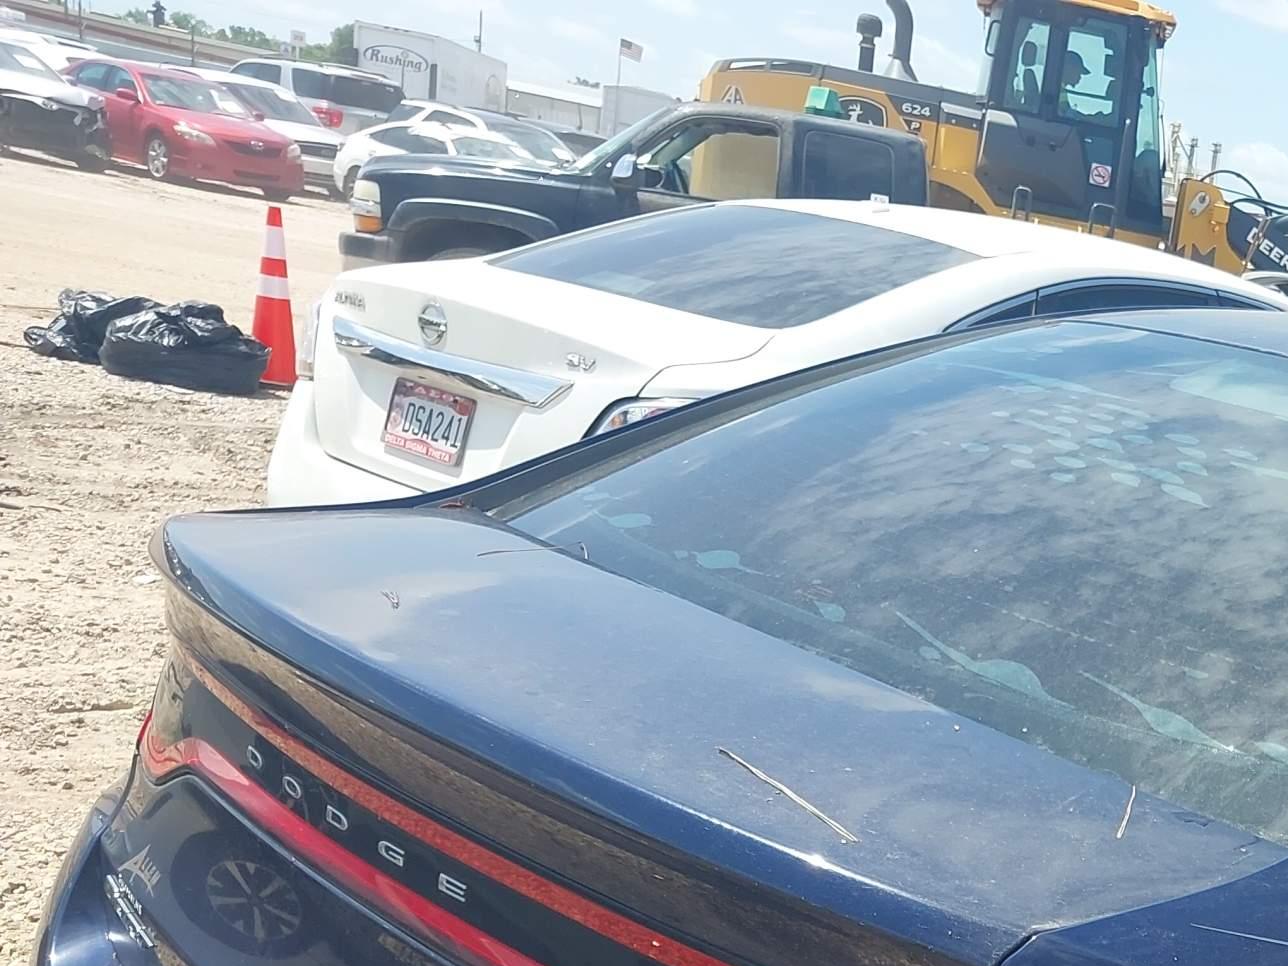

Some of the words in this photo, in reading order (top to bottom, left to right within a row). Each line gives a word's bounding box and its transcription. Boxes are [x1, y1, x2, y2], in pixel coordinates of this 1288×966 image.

[370, 48, 423, 73] Rushing
[901, 102, 931, 117] 624
[910, 121, 921, 131] P
[402, 402, 463, 449] DSA241
[246, 745, 468, 903] DODGE
